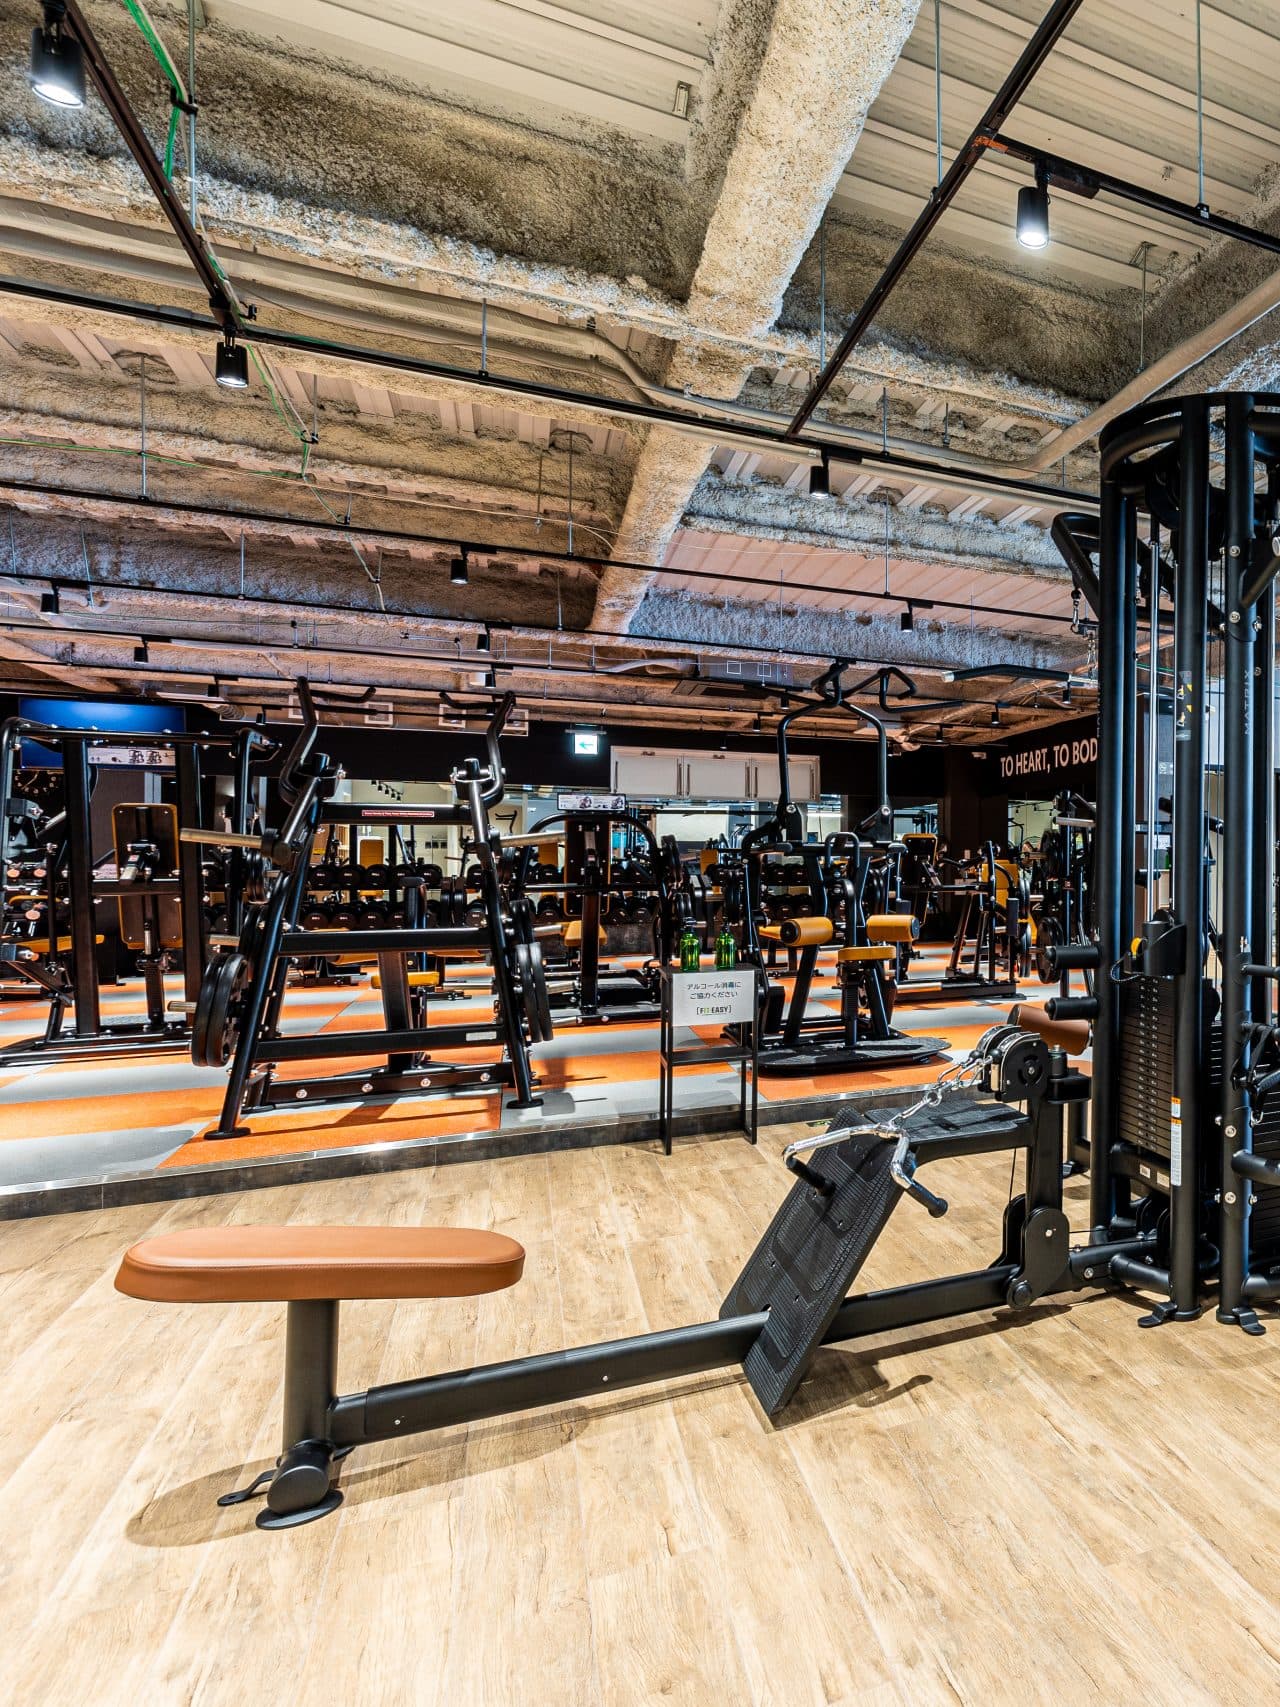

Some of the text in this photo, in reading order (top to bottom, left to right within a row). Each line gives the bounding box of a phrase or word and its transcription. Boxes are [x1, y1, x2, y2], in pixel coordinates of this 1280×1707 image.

[1000, 737, 1098, 778] TO HEART, TO BOD
